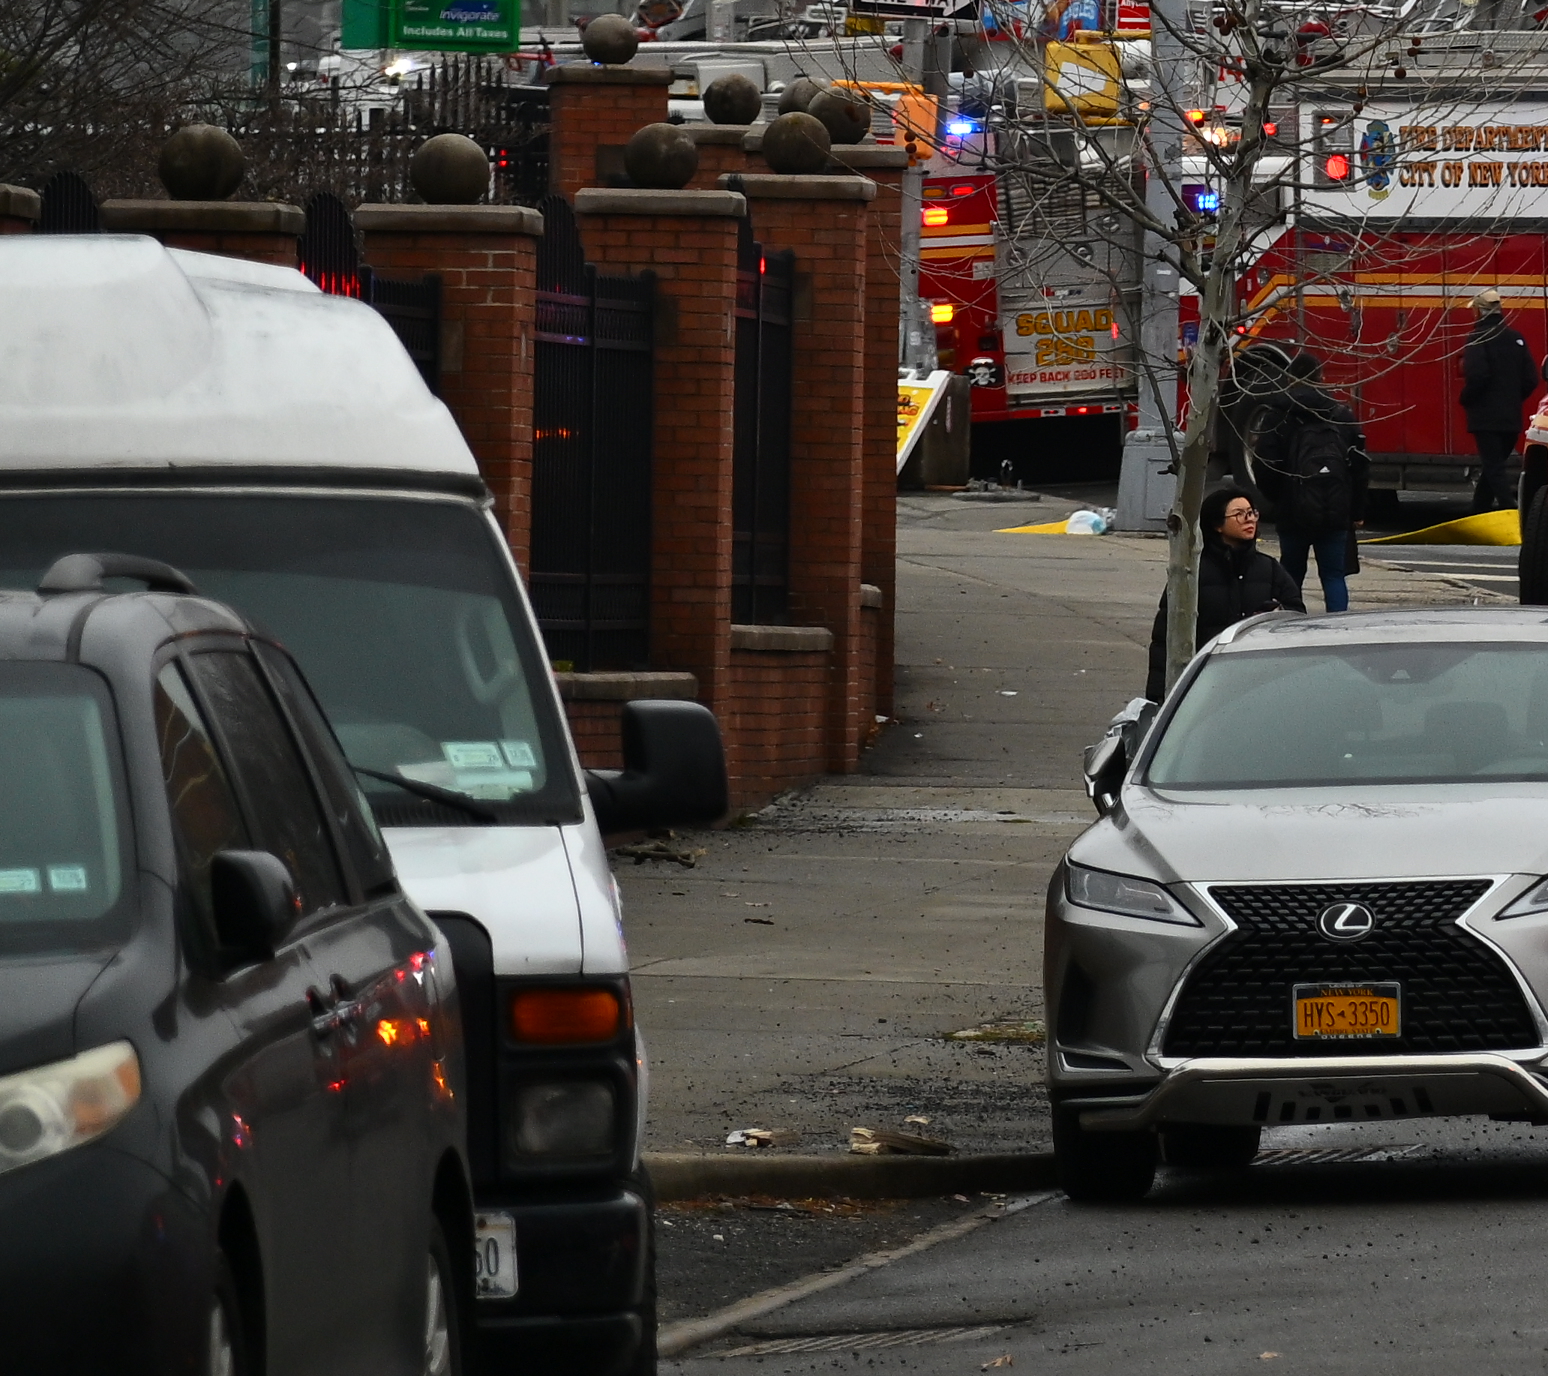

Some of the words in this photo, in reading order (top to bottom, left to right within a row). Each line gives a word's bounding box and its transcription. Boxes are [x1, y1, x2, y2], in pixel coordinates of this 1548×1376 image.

[1399, 161, 1437, 189] CITY
[1440, 161, 1464, 188] OF
[1467, 160, 1506, 188] NEW
[1015, 308, 1114, 337] SQUAD
[1007, 371, 1037, 385] KEEP
[1039, 369, 1071, 384] BACK
[1099, 367, 1126, 379] FEET
[1320, 988, 1344, 997] NEW
[1347, 988, 1375, 997] YORK
[1303, 1001, 1336, 1028] HYS
[1348, 1000, 1391, 1027] 3350
